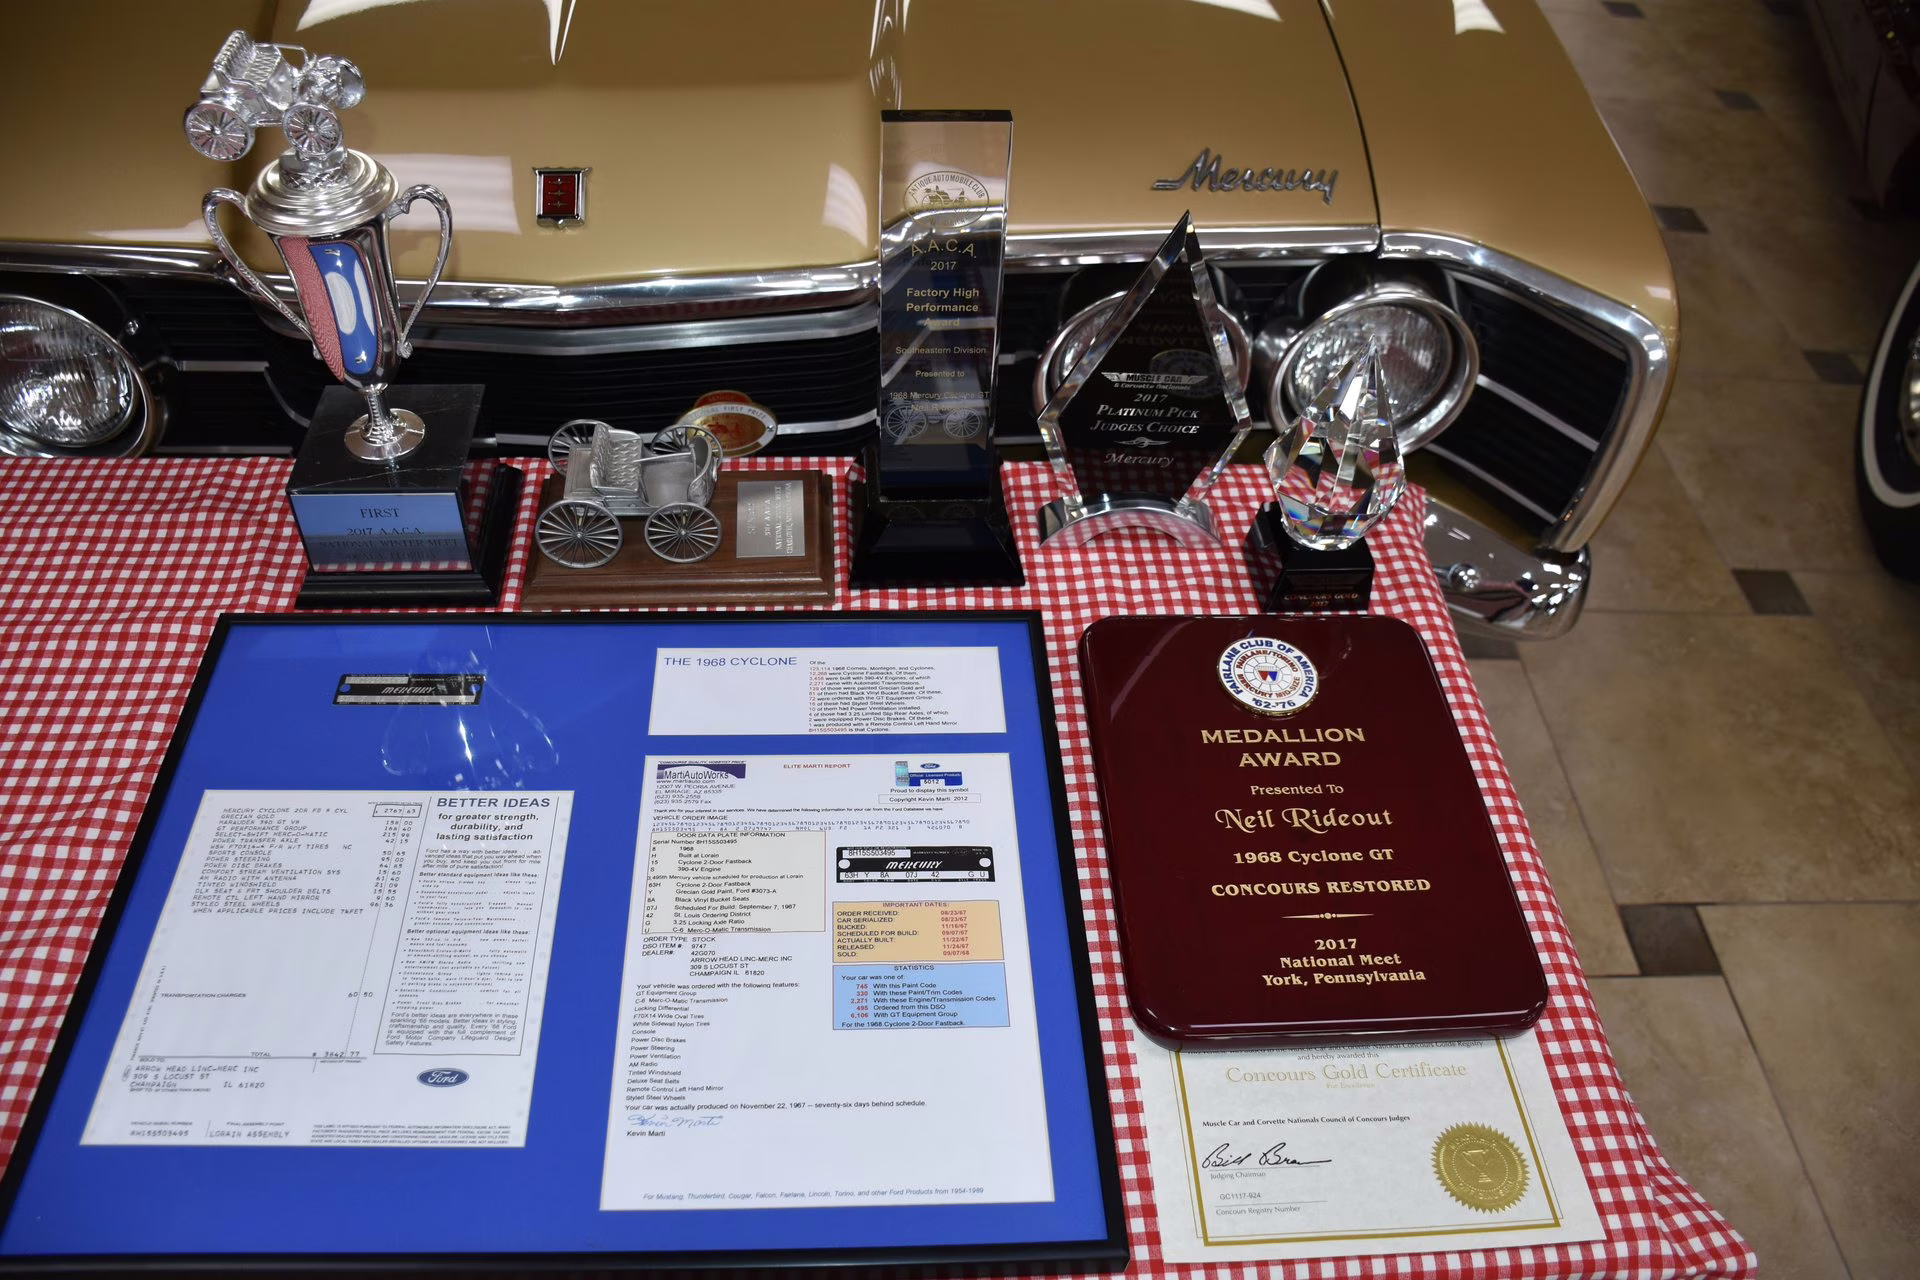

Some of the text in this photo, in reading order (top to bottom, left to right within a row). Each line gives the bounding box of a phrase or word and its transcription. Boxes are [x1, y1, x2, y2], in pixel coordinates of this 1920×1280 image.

[1152, 148, 1336, 204] Mercury
[908, 174, 986, 198] ANTIQUE AUTOMOBILE CLUB
[931, 261, 956, 270] 2017
[906, 288, 979, 298] Factory High
[906, 303, 979, 312] Performance
[924, 318, 960, 326] Award
[895, 346, 951, 354] Southeastern
[1126, 374, 1160, 382] MUSCLE
[910, 392, 940, 400] Mercury
[1134, 393, 1168, 403] 2017
[747, 408, 767, 419] PRIZE
[1096, 405, 1199, 419] PLATINUM PICK
[1090, 420, 1200, 434] JUDGES CHOICE
[1104, 452, 1174, 468] Mercury
[360, 508, 400, 518] FIRST
[346, 528, 373, 536] 2017
[664, 657, 797, 667] THE 1968 CYCLONE
[1222, 640, 1315, 698] FAIRLANE CLUB OF AMERICA
[381, 686, 436, 694] MERCURY
[1237, 674, 1301, 698] MERCURY MID-SIZE
[1201, 728, 1366, 744] MEDALLION
[1239, 752, 1341, 767] AWARD
[664, 770, 729, 780] MartiAutoWorks
[1250, 784, 1344, 795] Presented To
[437, 798, 551, 807] BETTER IDEAS
[438, 813, 539, 822] for greater strength,
[1215, 808, 1393, 834] Neil Rideout
[450, 823, 501, 831] durability,
[436, 833, 533, 841] lasting satisfaction
[1233, 849, 1394, 865] 1968 Cyclone GT
[885, 861, 943, 870] MERCURY
[1211, 879, 1431, 896] CONCOURS RESTORED
[1315, 939, 1357, 950] 2017
[1280, 953, 1401, 968] National Meet
[1263, 969, 1426, 986] York, Pennsylvania
[428, 1071, 457, 1083] Ford
[1226, 1062, 1468, 1082] Concours Gold Certificate
[1210, 1172, 1234, 1180] Judging
[1220, 1192, 1261, 1200] GC1117-924
